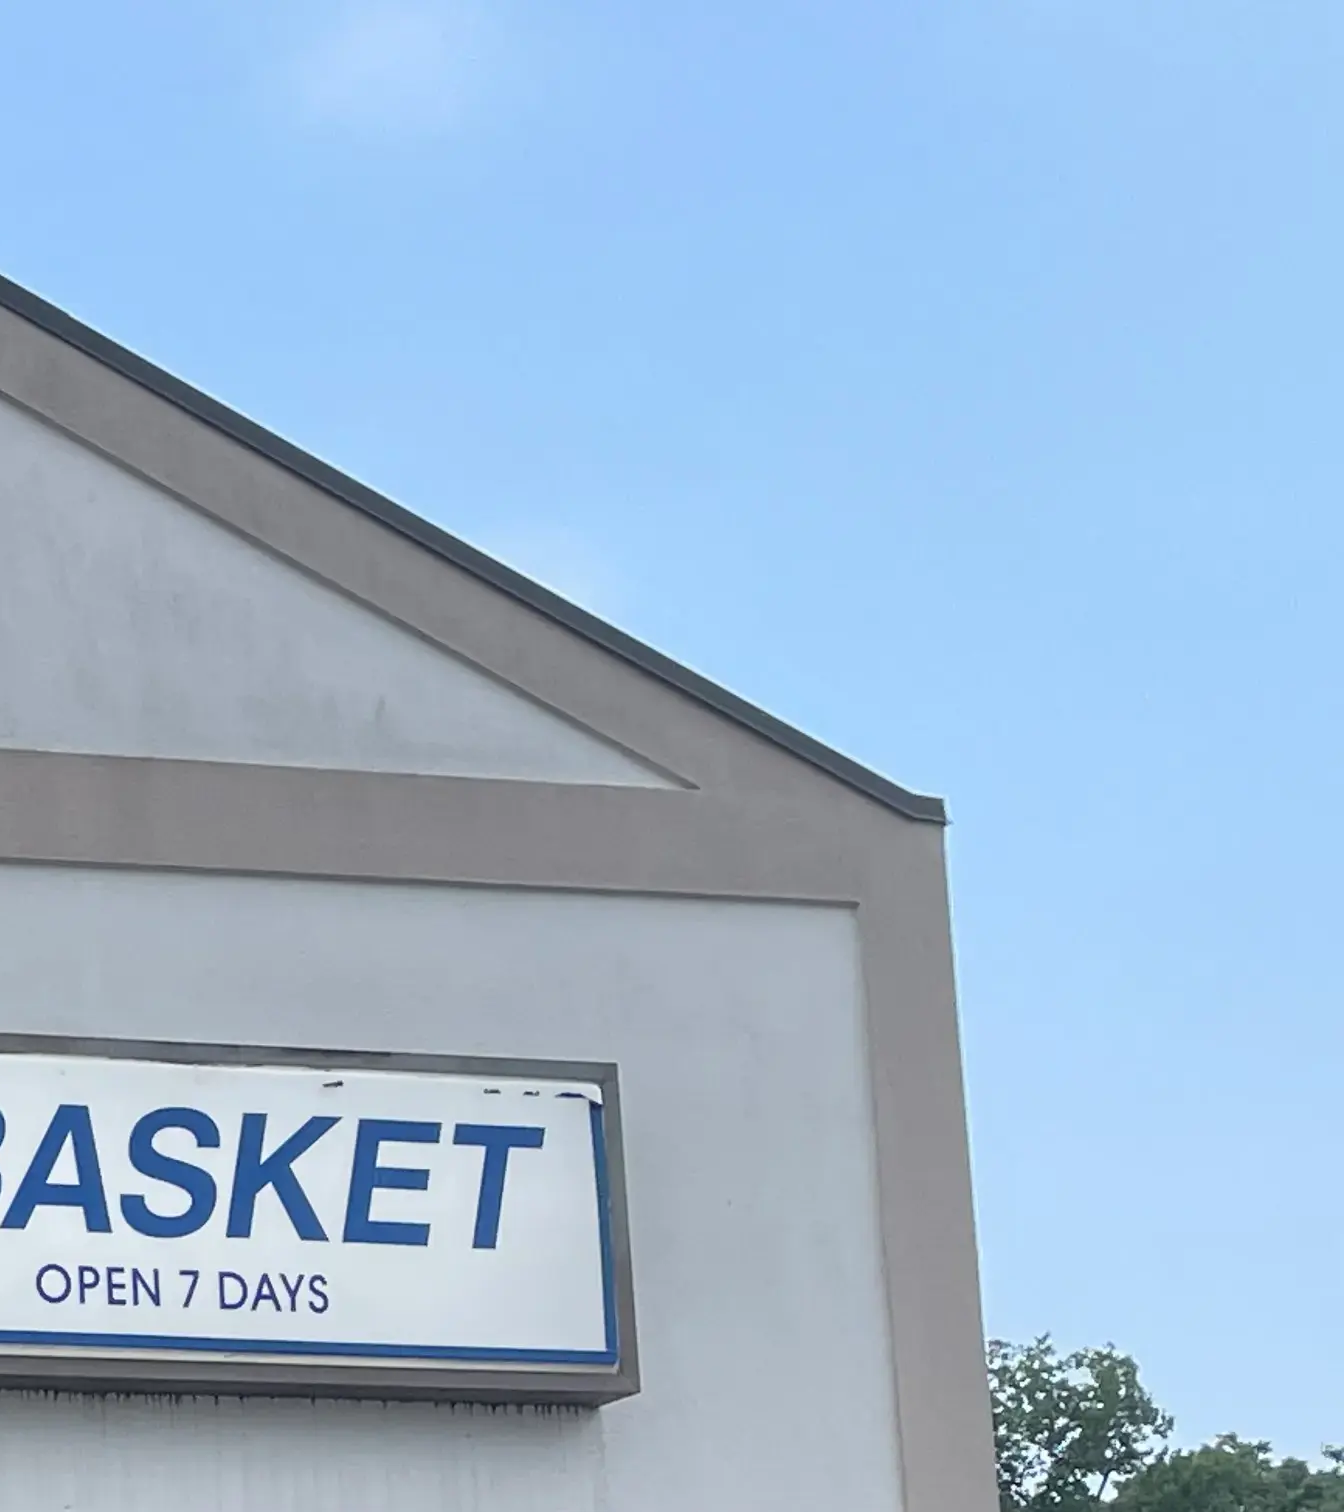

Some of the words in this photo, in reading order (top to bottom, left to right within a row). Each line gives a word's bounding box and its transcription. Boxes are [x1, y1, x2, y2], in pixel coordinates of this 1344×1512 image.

[36, 1264, 161, 1307] OPEN
[180, 1270, 200, 1308] 7
[219, 1272, 330, 1314] DAYS
